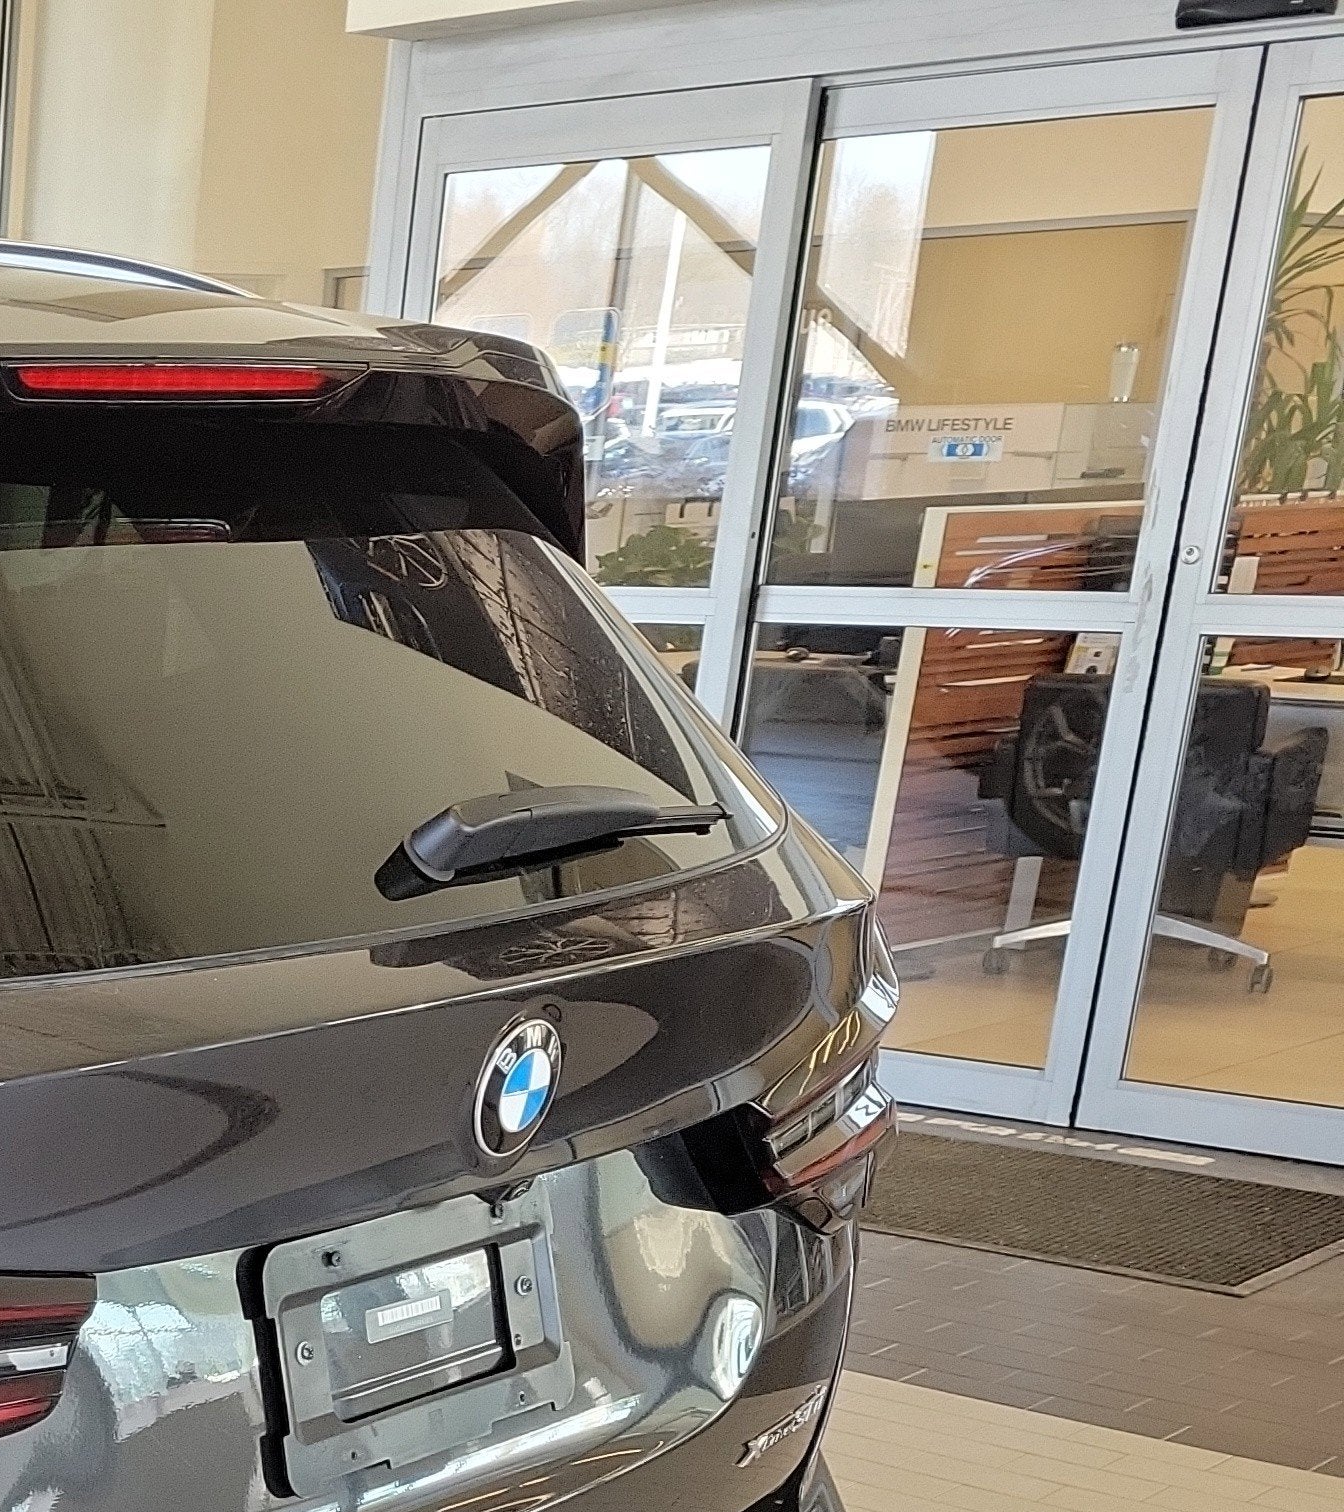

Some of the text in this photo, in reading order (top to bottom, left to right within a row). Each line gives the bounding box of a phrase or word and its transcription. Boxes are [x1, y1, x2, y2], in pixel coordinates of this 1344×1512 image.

[885, 417, 1014, 432] BMW LIFESTYLE
[931, 435, 1003, 444] AUTOMATIC DOOR
